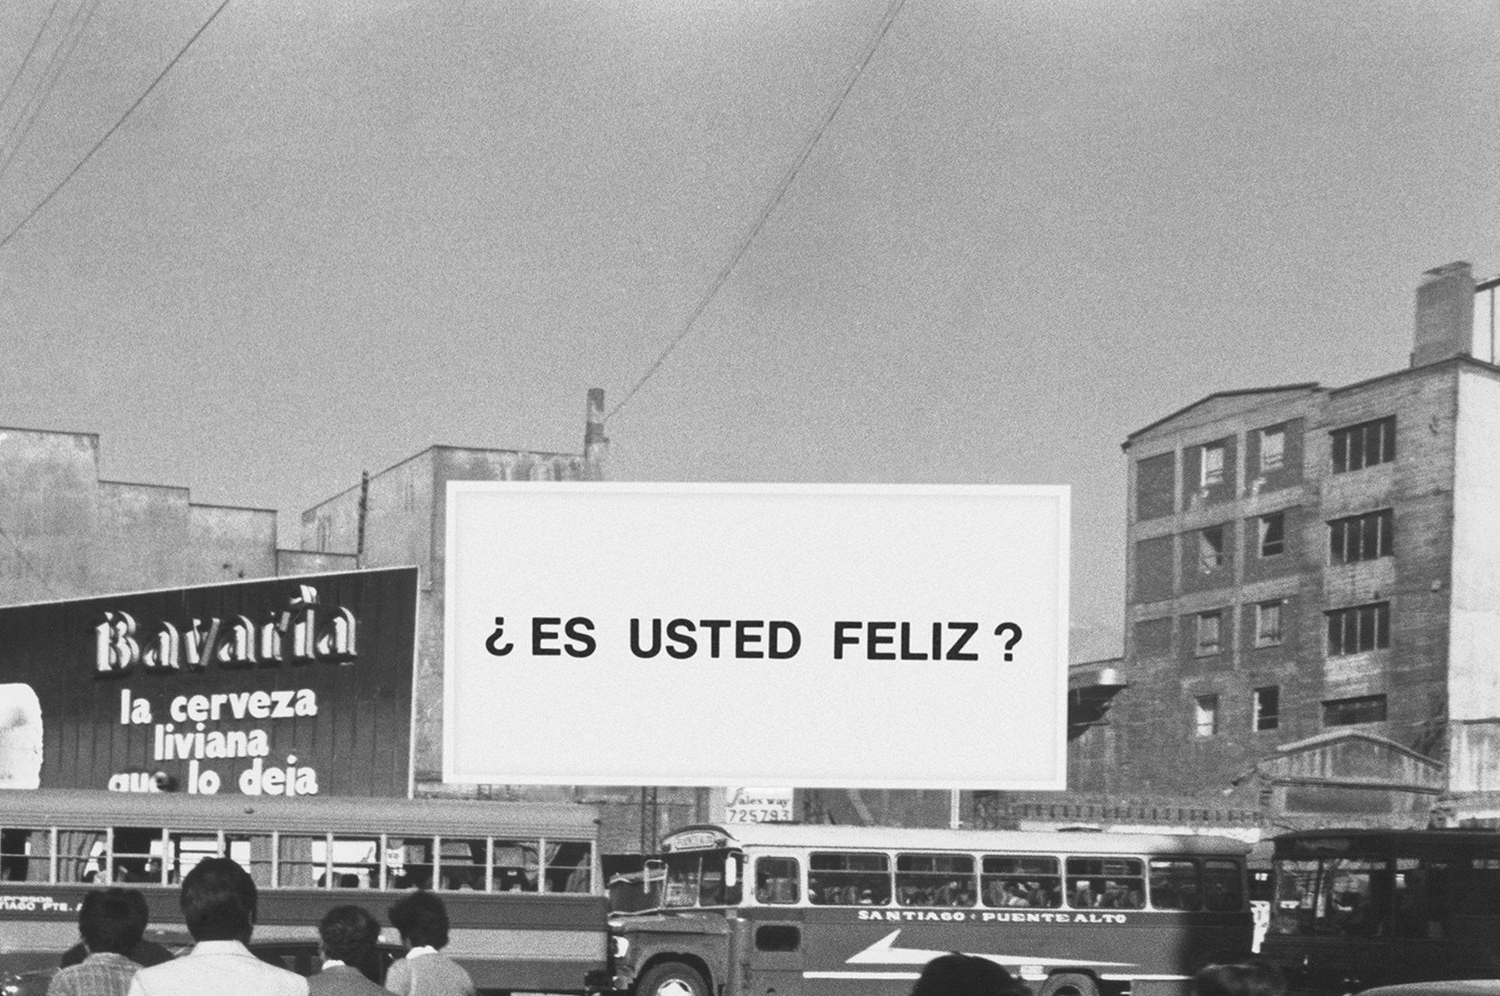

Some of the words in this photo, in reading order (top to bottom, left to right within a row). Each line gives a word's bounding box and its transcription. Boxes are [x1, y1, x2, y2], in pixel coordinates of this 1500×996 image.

[95, 583, 358, 672] Bavaria
[629, 617, 802, 660] USTED
[120, 688, 152, 725] la
[170, 688, 318, 722] cerveza
[154, 722, 269, 760] liviana
[188, 759, 220, 795] lo
[857, 910, 965, 922] SANTIAGO
[982, 911, 1069, 923] PUENTE
[1073, 914, 1127, 924] ALTO
